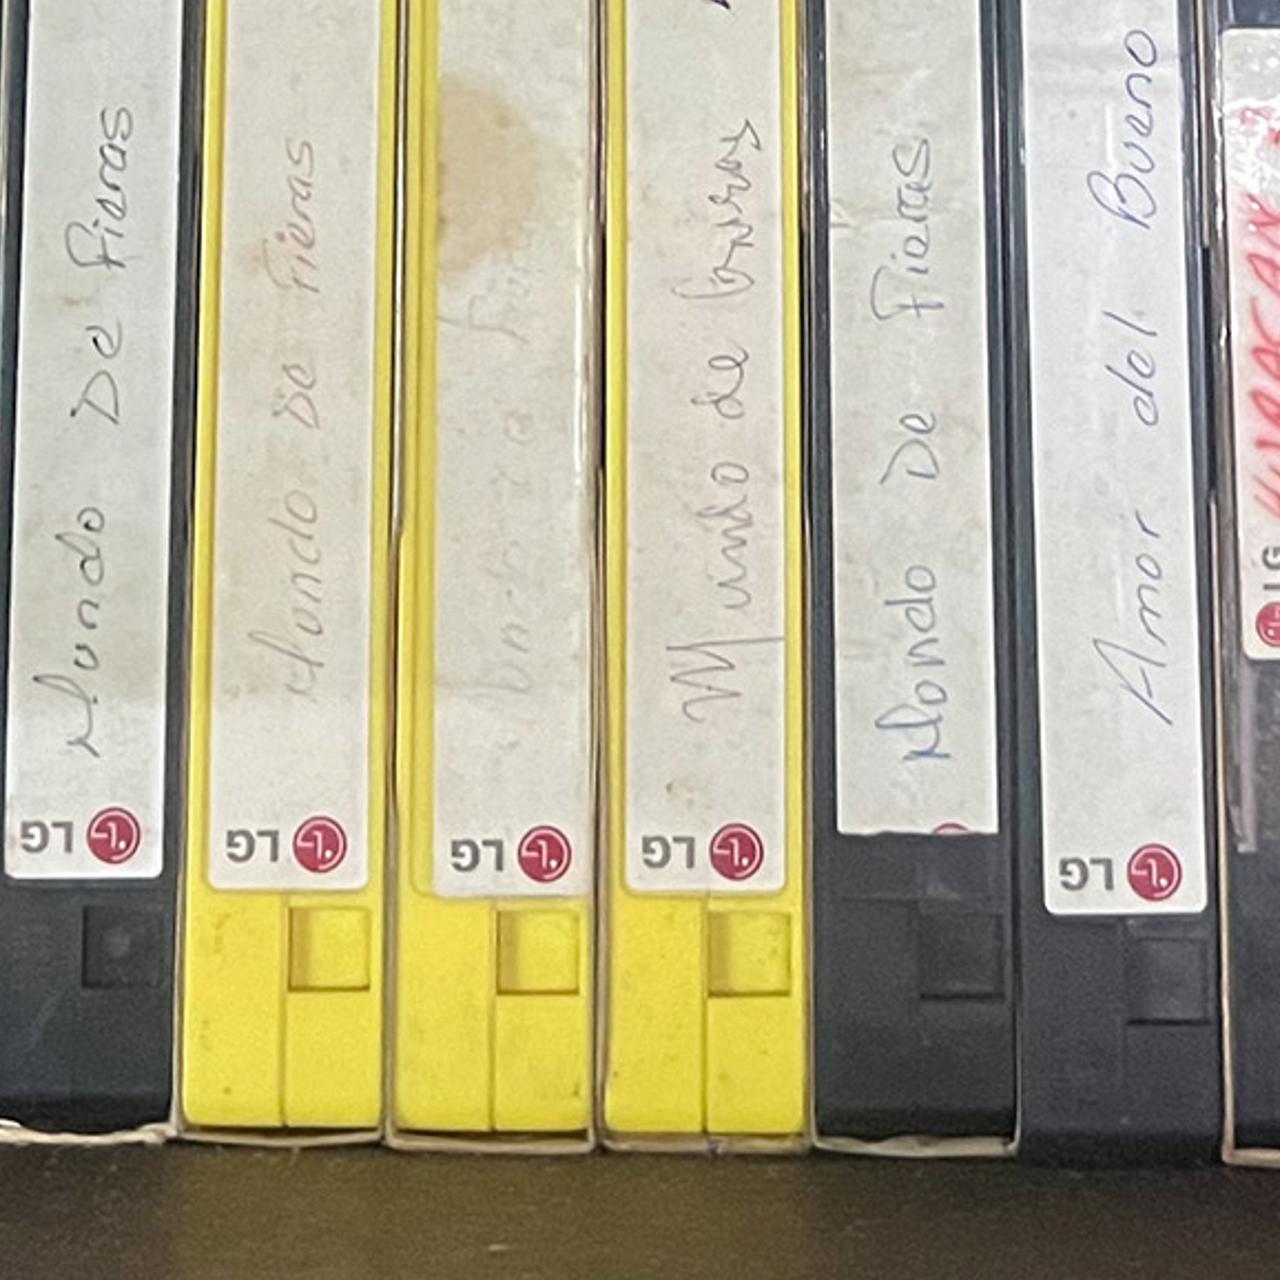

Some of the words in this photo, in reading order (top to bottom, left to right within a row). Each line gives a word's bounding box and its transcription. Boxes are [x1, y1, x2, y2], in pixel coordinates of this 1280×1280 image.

[1086, 28, 1159, 230] Bueno
[1102, 310, 1161, 428] del
[1092, 509, 1174, 727] Amor
[20, 819, 74, 853] LG
[225, 828, 280, 863] LG
[641, 834, 695, 869] LG
[450, 837, 506, 872] LG
[1060, 856, 1115, 891] LG
